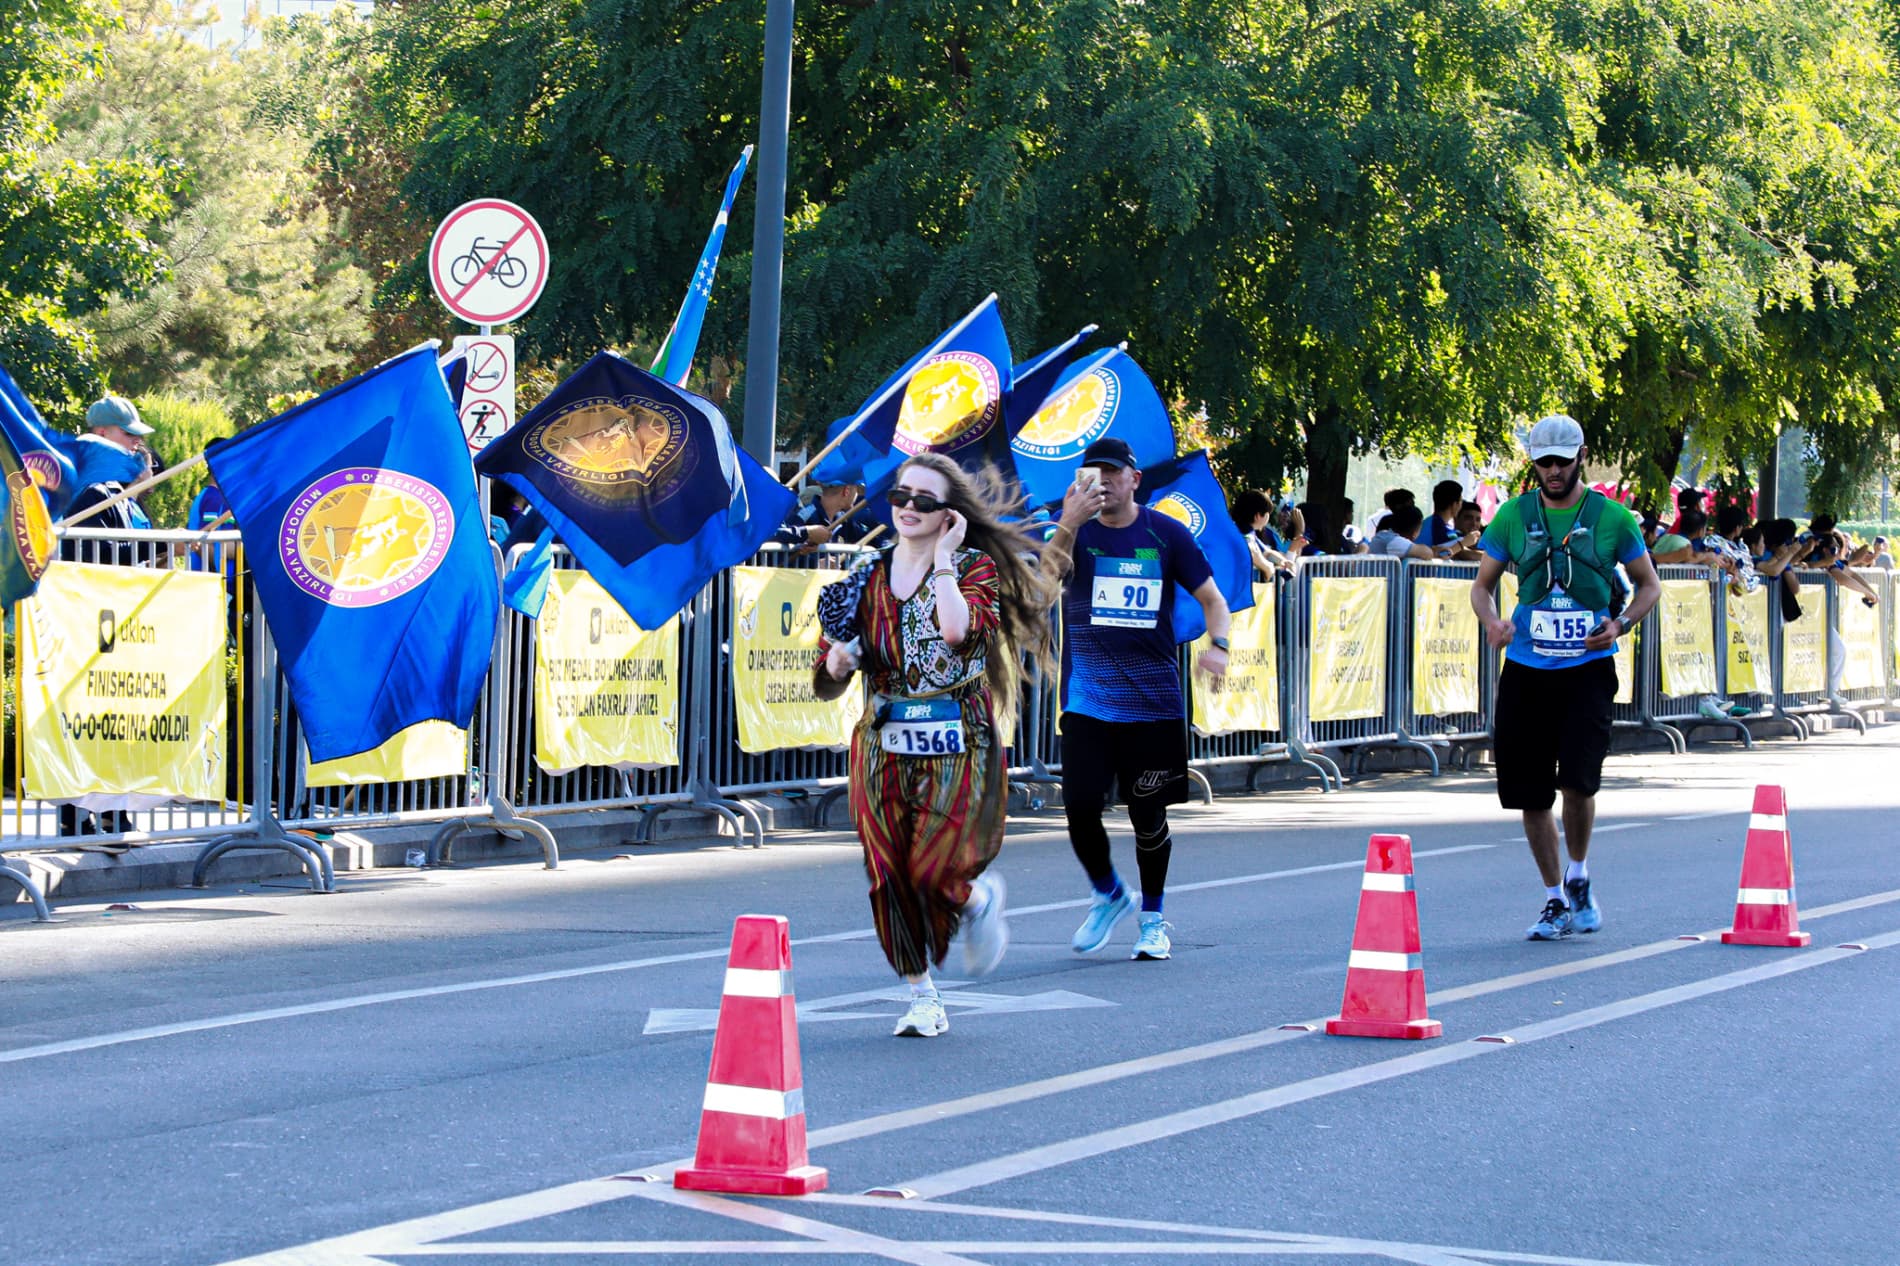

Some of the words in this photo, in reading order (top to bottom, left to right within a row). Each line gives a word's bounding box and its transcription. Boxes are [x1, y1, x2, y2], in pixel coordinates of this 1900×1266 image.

[546, 458, 625, 480] VAZIRLIGI
[285, 489, 323, 556] MUDOFAA
[393, 510, 449, 589] RESPUBLIKASI
[290, 559, 353, 602] VAZIRLIGI
[1097, 590, 1107, 601] A
[1123, 585, 1149, 608] 90
[120, 617, 155, 644] uklon
[1534, 623, 1543, 633] A
[1552, 617, 1586, 639] 155
[87, 670, 167, 698] FINISHGACHA
[150, 714, 189, 743] QOLDI!
[889, 733, 898, 745] B
[902, 729, 960, 754] 1568
